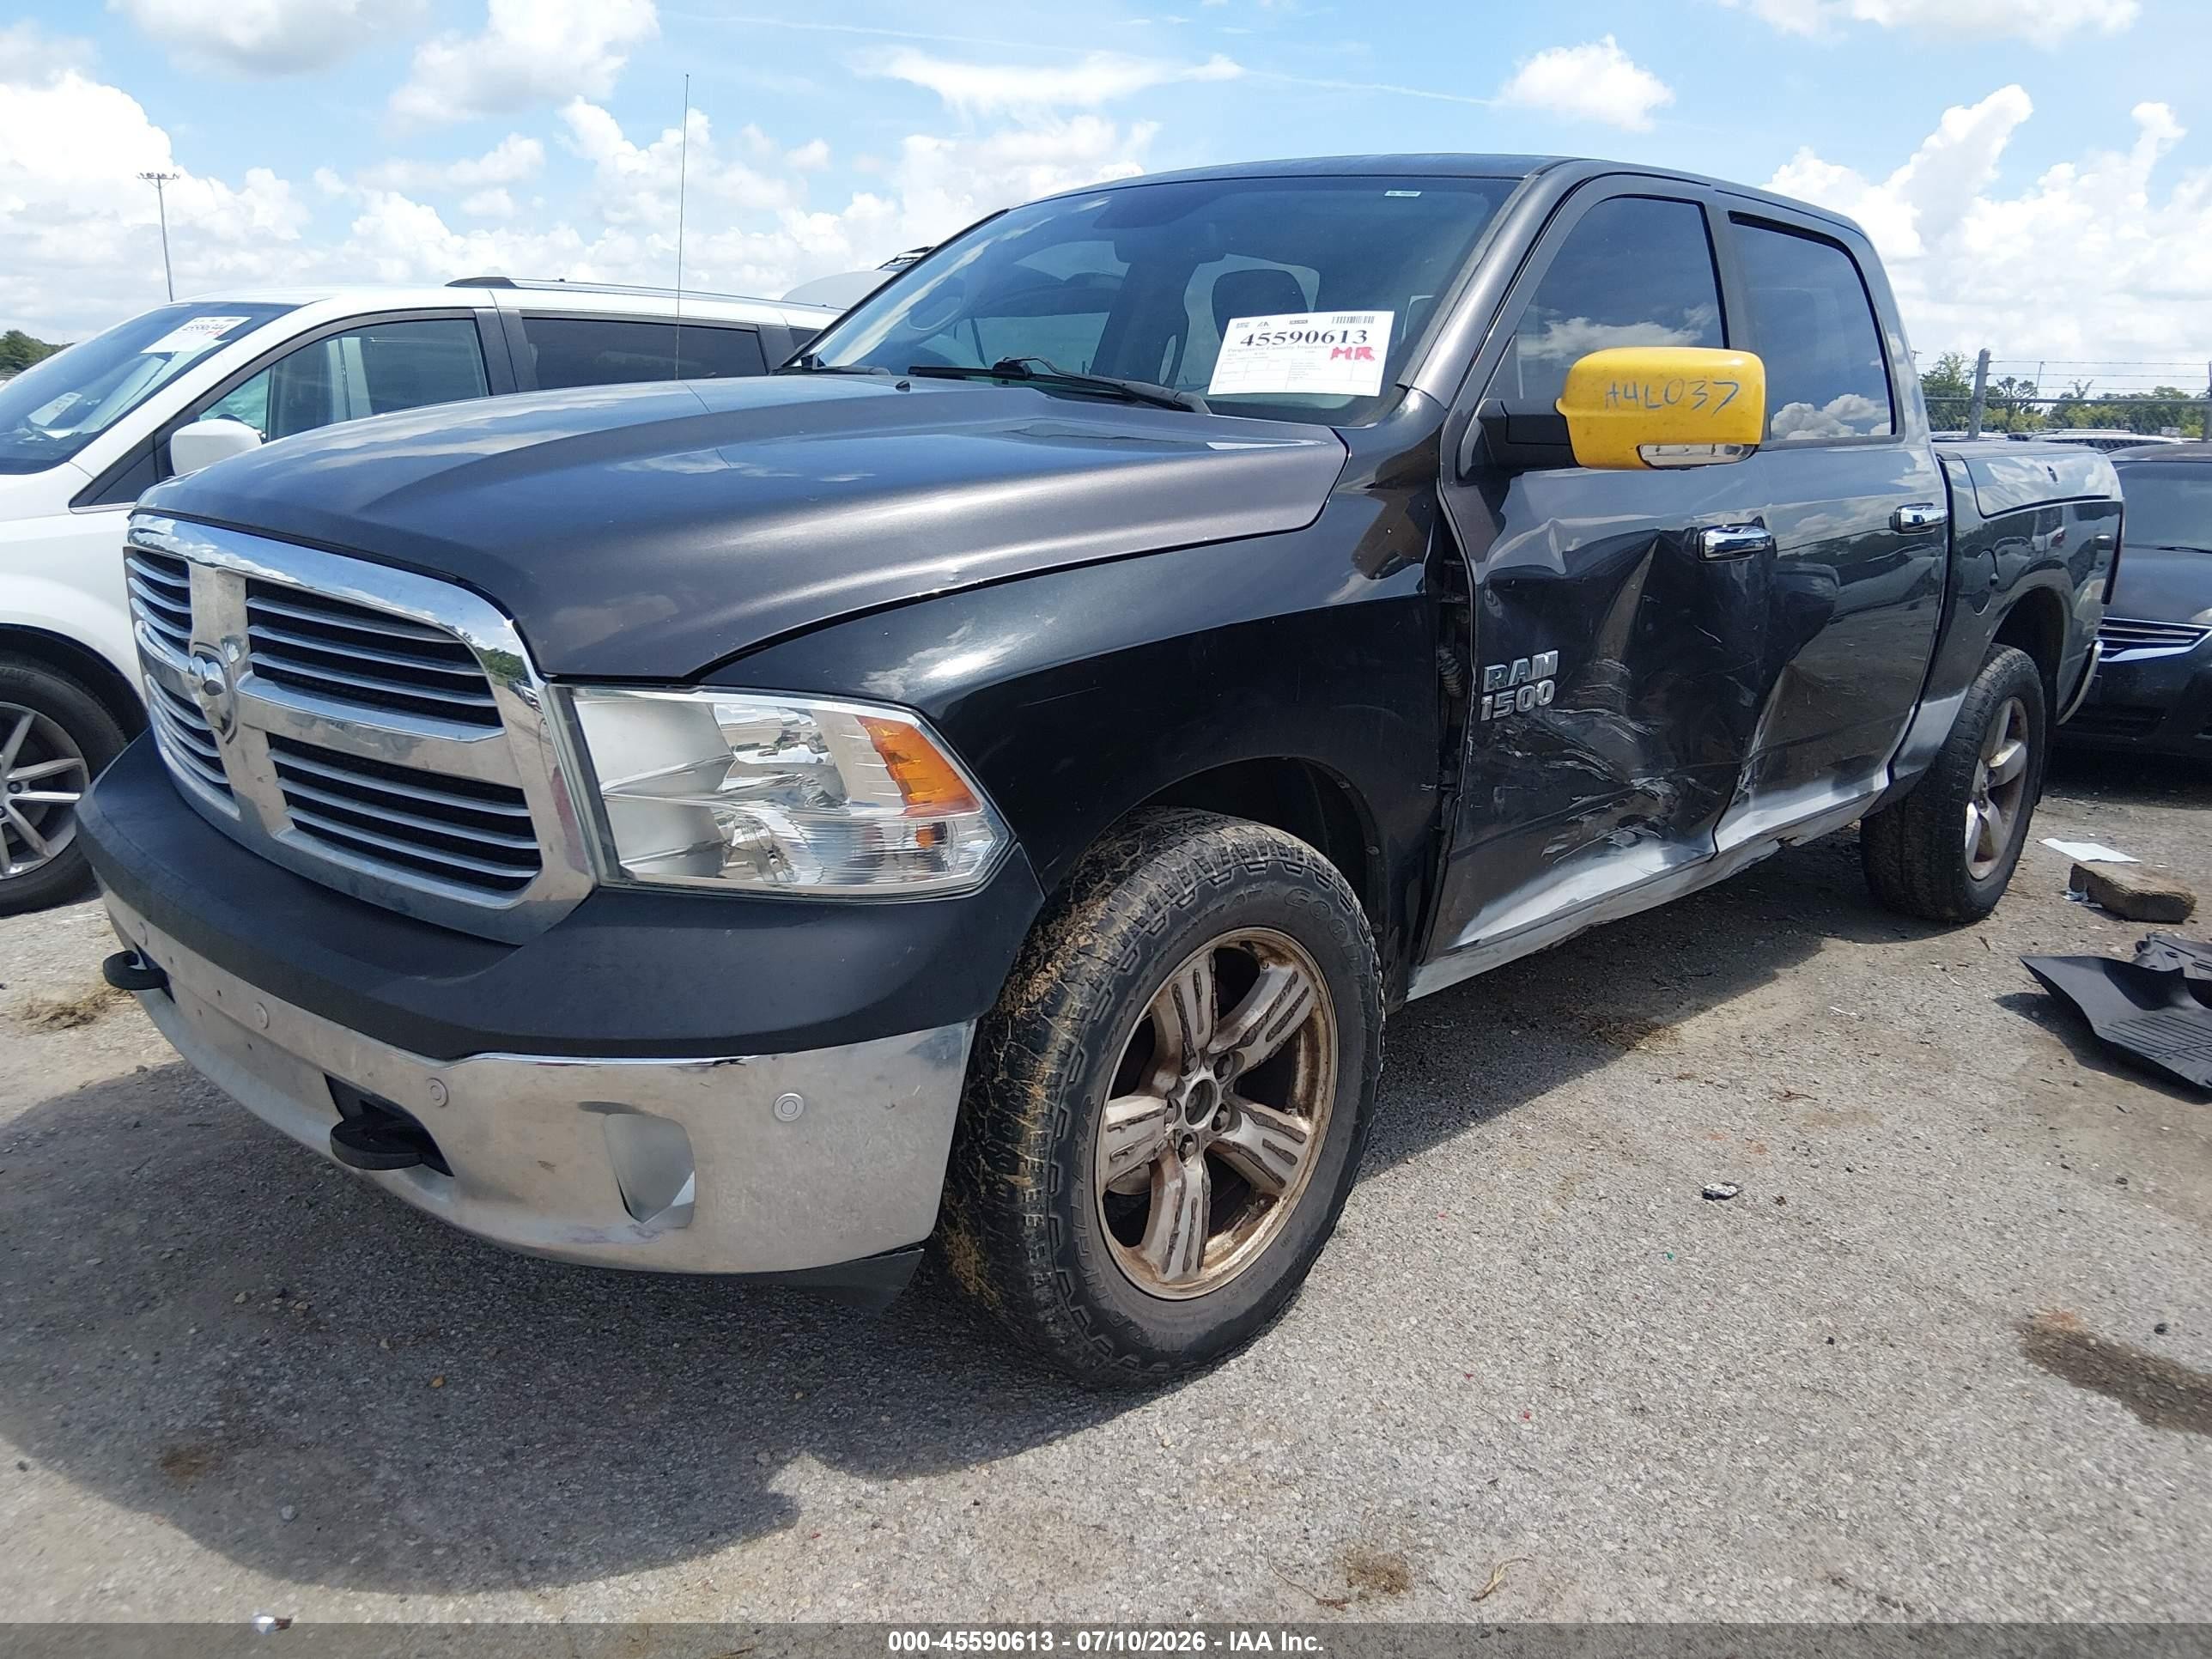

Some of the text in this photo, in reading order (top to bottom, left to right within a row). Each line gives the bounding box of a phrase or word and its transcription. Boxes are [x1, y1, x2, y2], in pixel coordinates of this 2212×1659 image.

[1240, 330, 1368, 347] 45590613
[1605, 379, 1739, 417] H4L037
[1482, 650, 1559, 693] RAM
[1480, 679, 1555, 721] 1500
